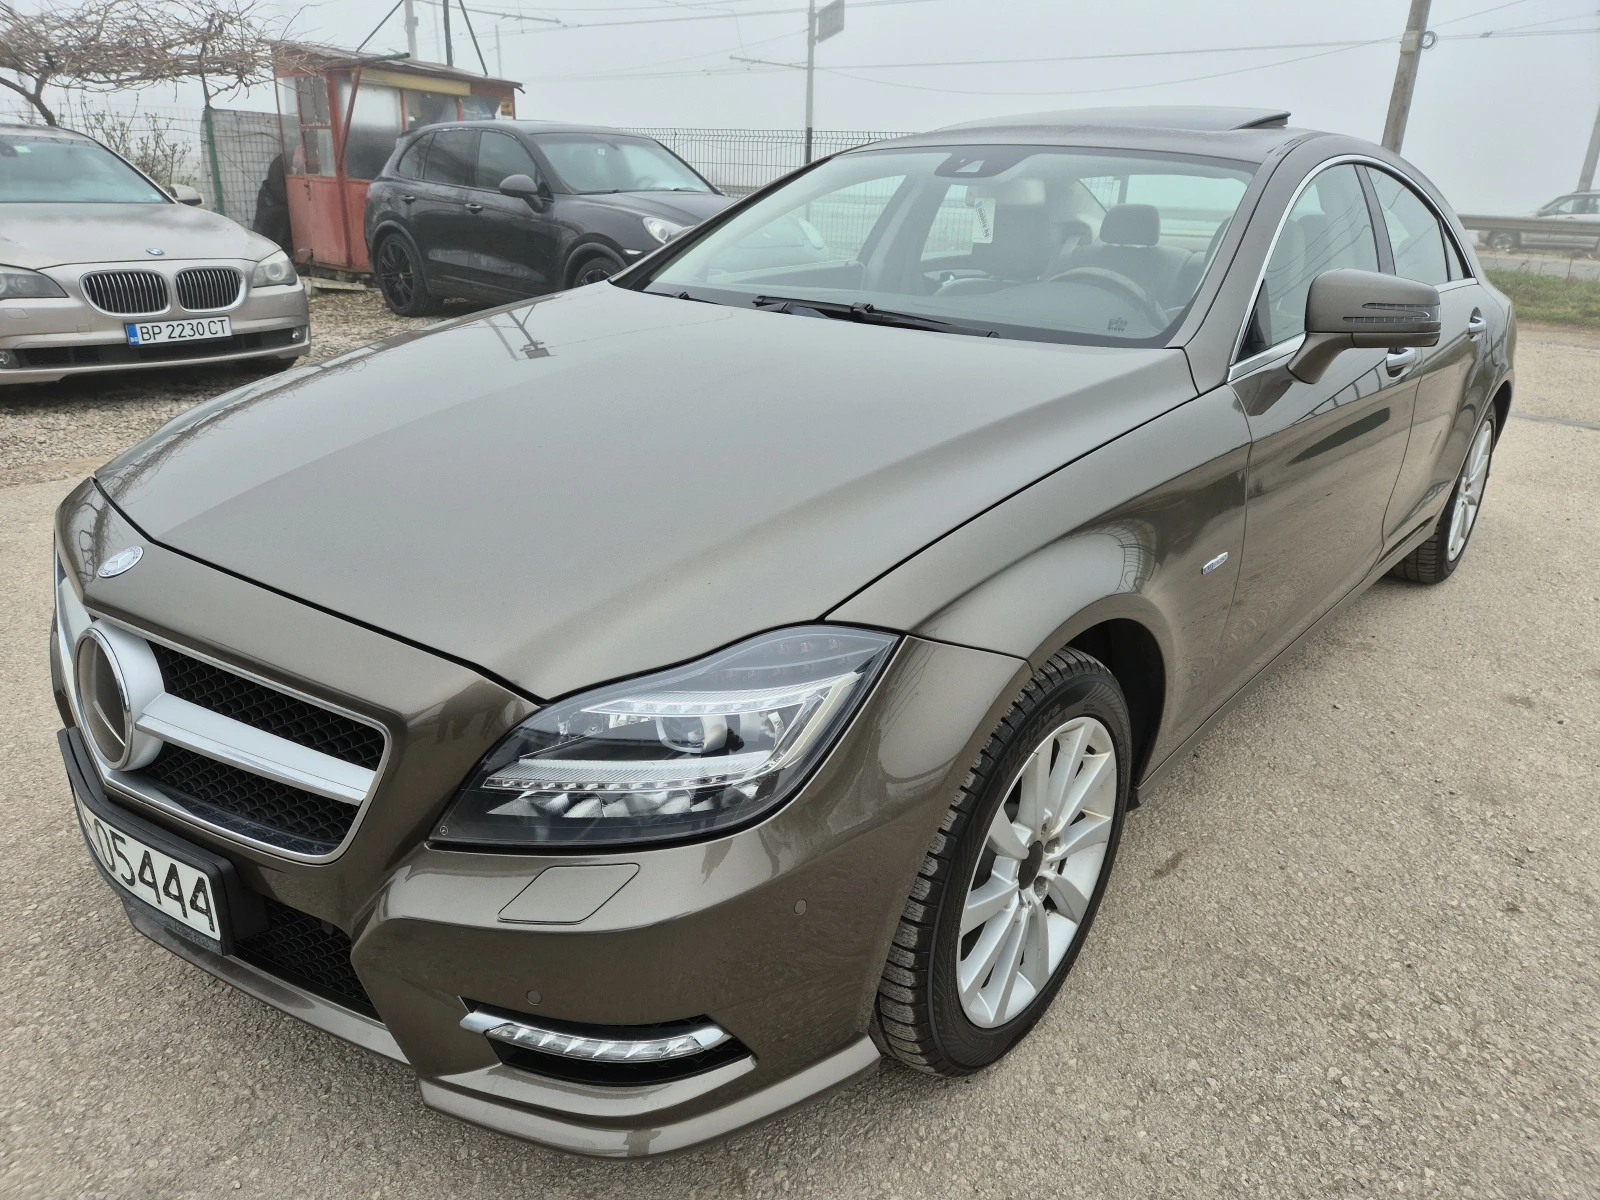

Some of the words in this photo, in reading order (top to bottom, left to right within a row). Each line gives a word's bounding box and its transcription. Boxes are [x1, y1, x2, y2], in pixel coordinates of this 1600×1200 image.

[140, 325, 162, 341] BP
[166, 321, 205, 339] 2230
[208, 319, 227, 335] CT
